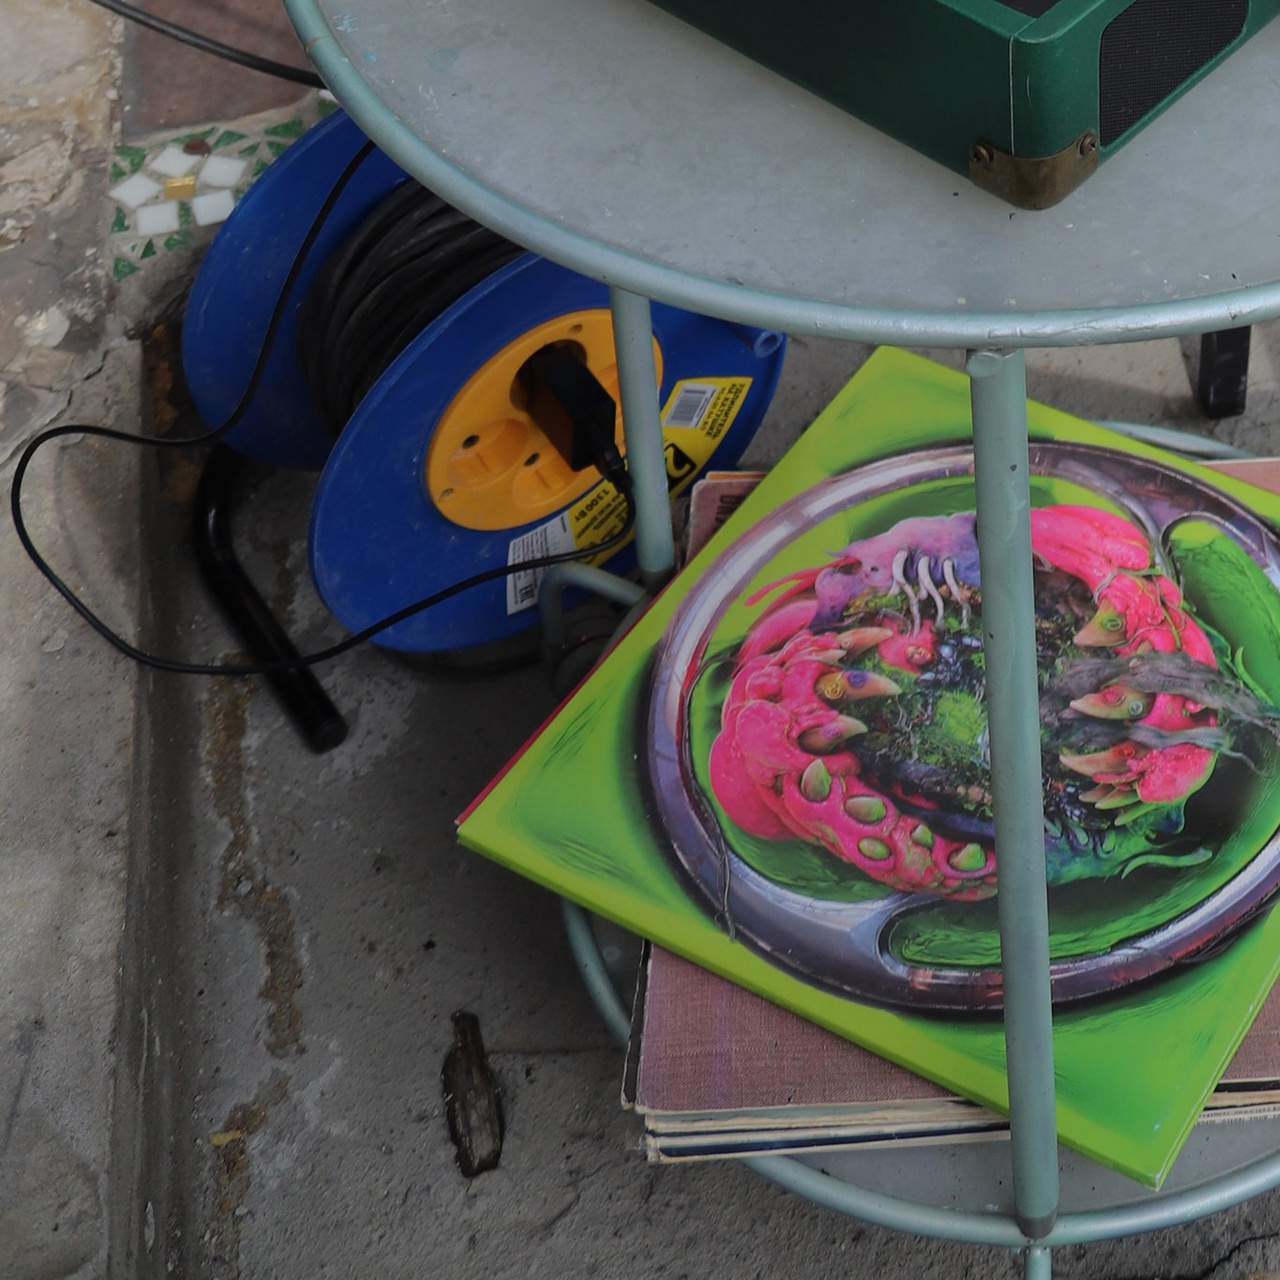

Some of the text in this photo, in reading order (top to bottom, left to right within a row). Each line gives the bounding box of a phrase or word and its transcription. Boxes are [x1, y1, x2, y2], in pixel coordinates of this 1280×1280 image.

[704, 397, 730, 438] КАТУШКЕ
[711, 382, 746, 441] УДЛИНИТЕЛЬ
[584, 488, 610, 512] 1300
